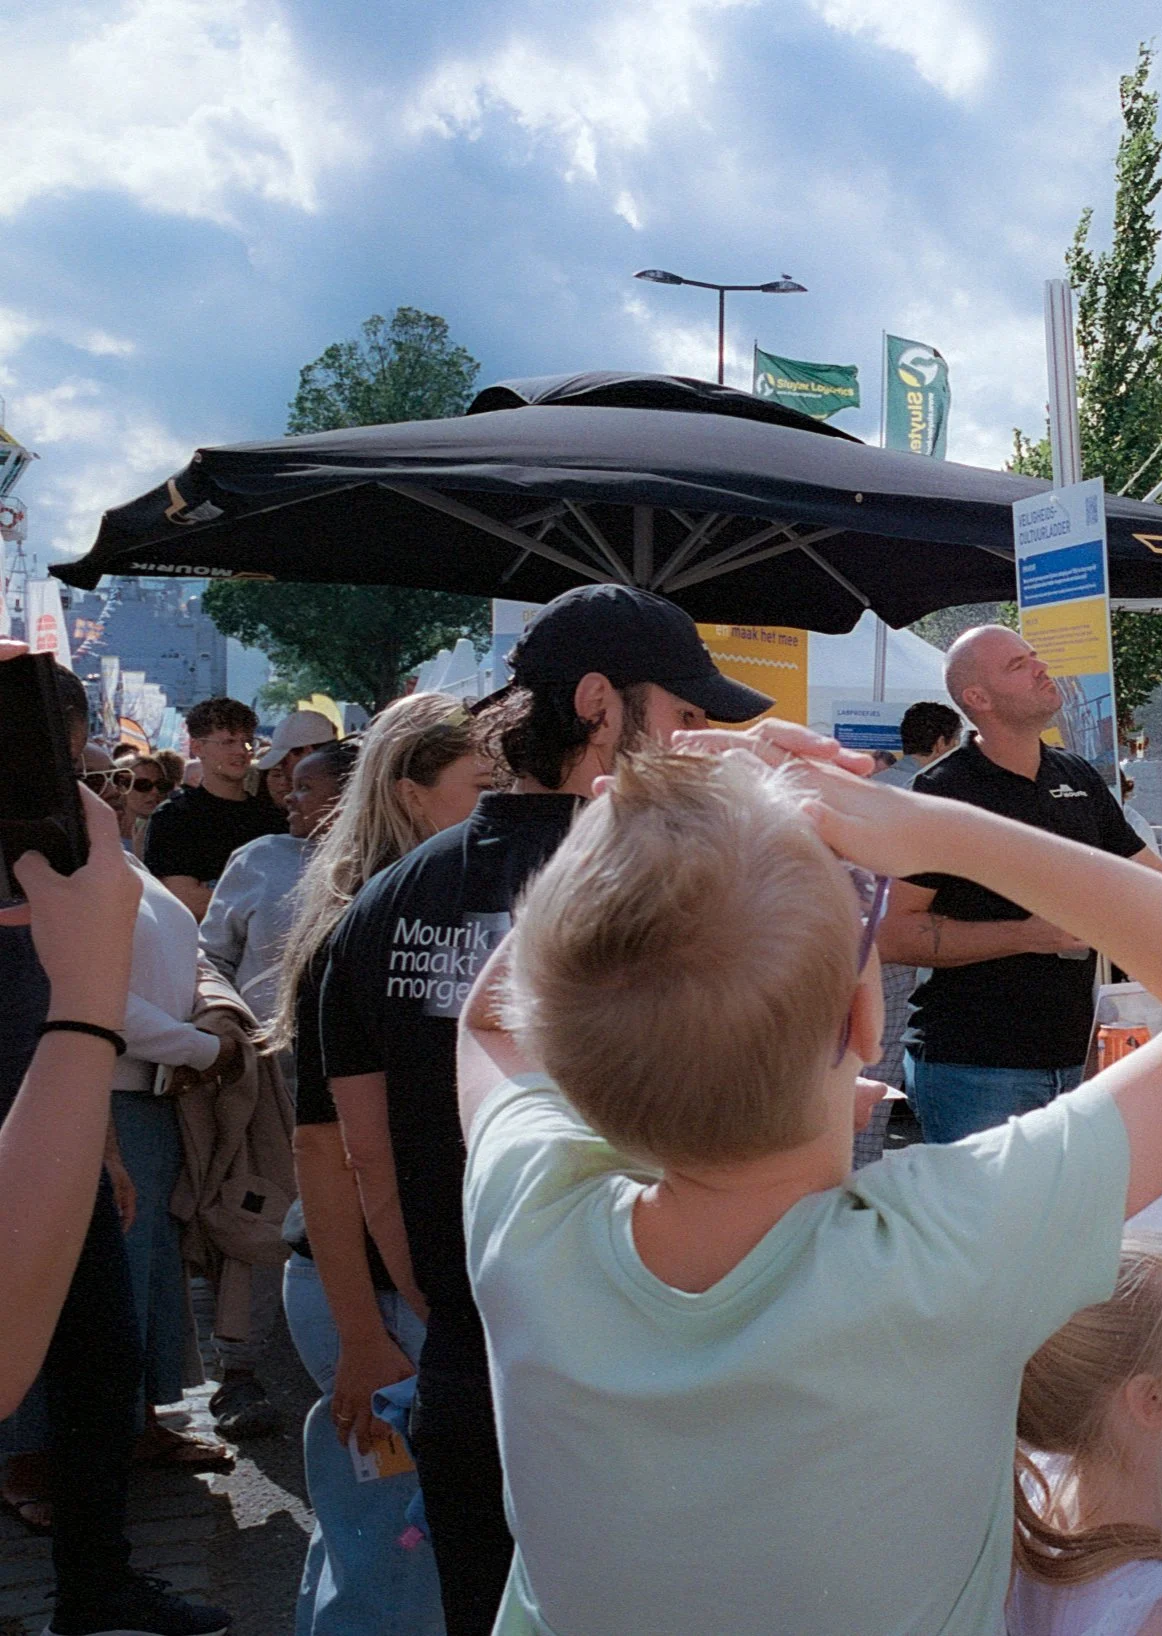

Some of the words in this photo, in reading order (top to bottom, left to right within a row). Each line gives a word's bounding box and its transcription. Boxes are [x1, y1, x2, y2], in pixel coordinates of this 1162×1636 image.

[130, 562, 234, 577] MOURIK
[730, 626, 758, 641] maak
[760, 628, 777, 644] het
[778, 633, 799, 647] mee
[393, 917, 490, 950] Mourik
[389, 949, 479, 976] maakt
[386, 976, 473, 1009] morge
